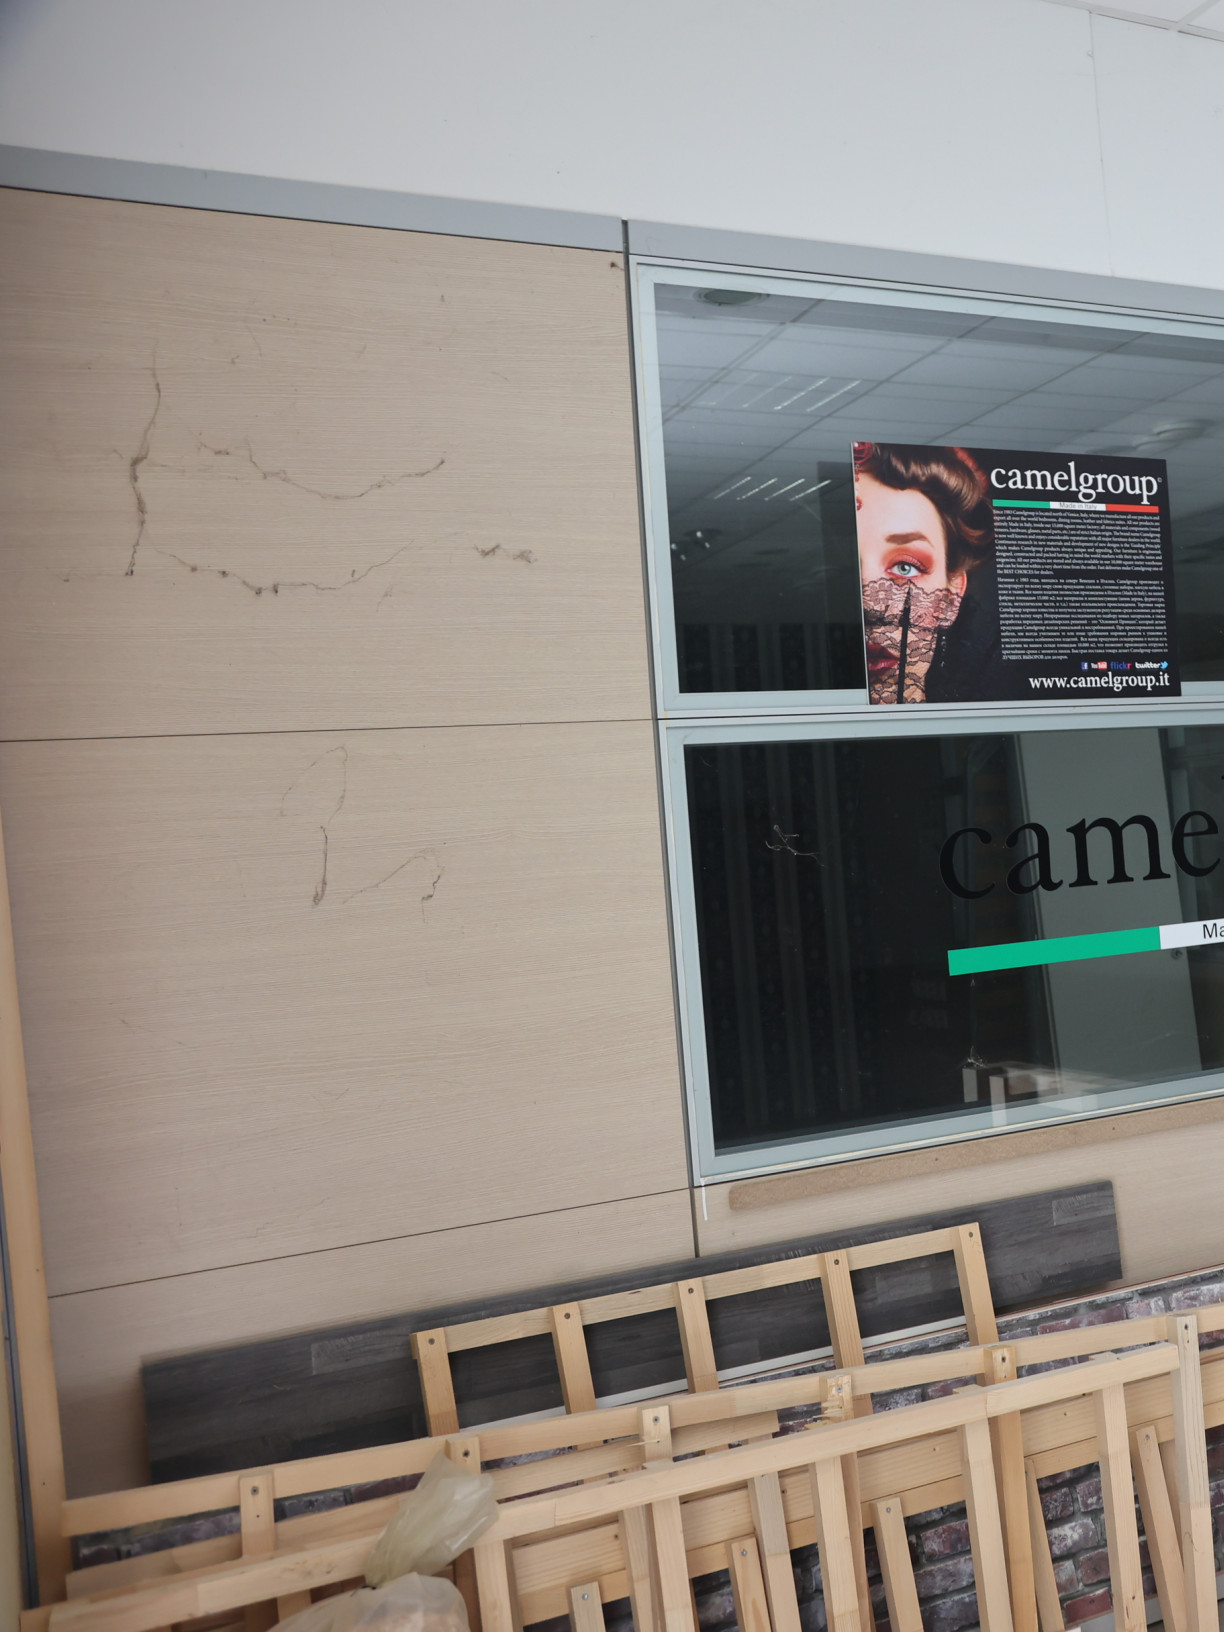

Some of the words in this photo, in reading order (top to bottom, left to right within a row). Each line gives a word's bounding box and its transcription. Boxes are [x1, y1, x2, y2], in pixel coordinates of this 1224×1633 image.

[991, 461, 1158, 504] camelgroup
[1110, 661, 1131, 669] flickr
[1135, 661, 1161, 669] twitter
[1028, 671, 1170, 692] www.camelgroup.it
